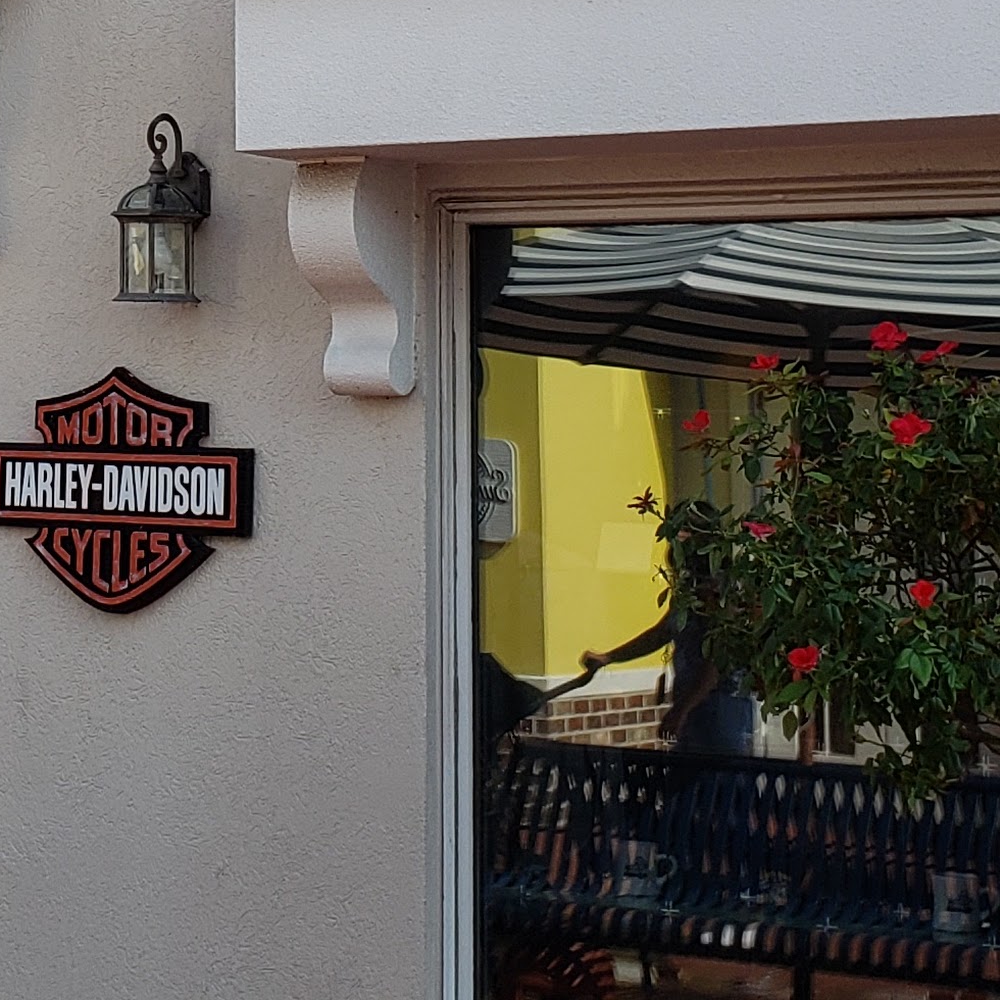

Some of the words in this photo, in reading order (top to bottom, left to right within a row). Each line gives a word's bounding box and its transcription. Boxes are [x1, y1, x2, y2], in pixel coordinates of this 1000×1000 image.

[57, 391, 173, 447] MOTOR
[4, 461, 225, 516] HARLEY-DAVIDSON
[53, 528, 170, 593] CYCLES
